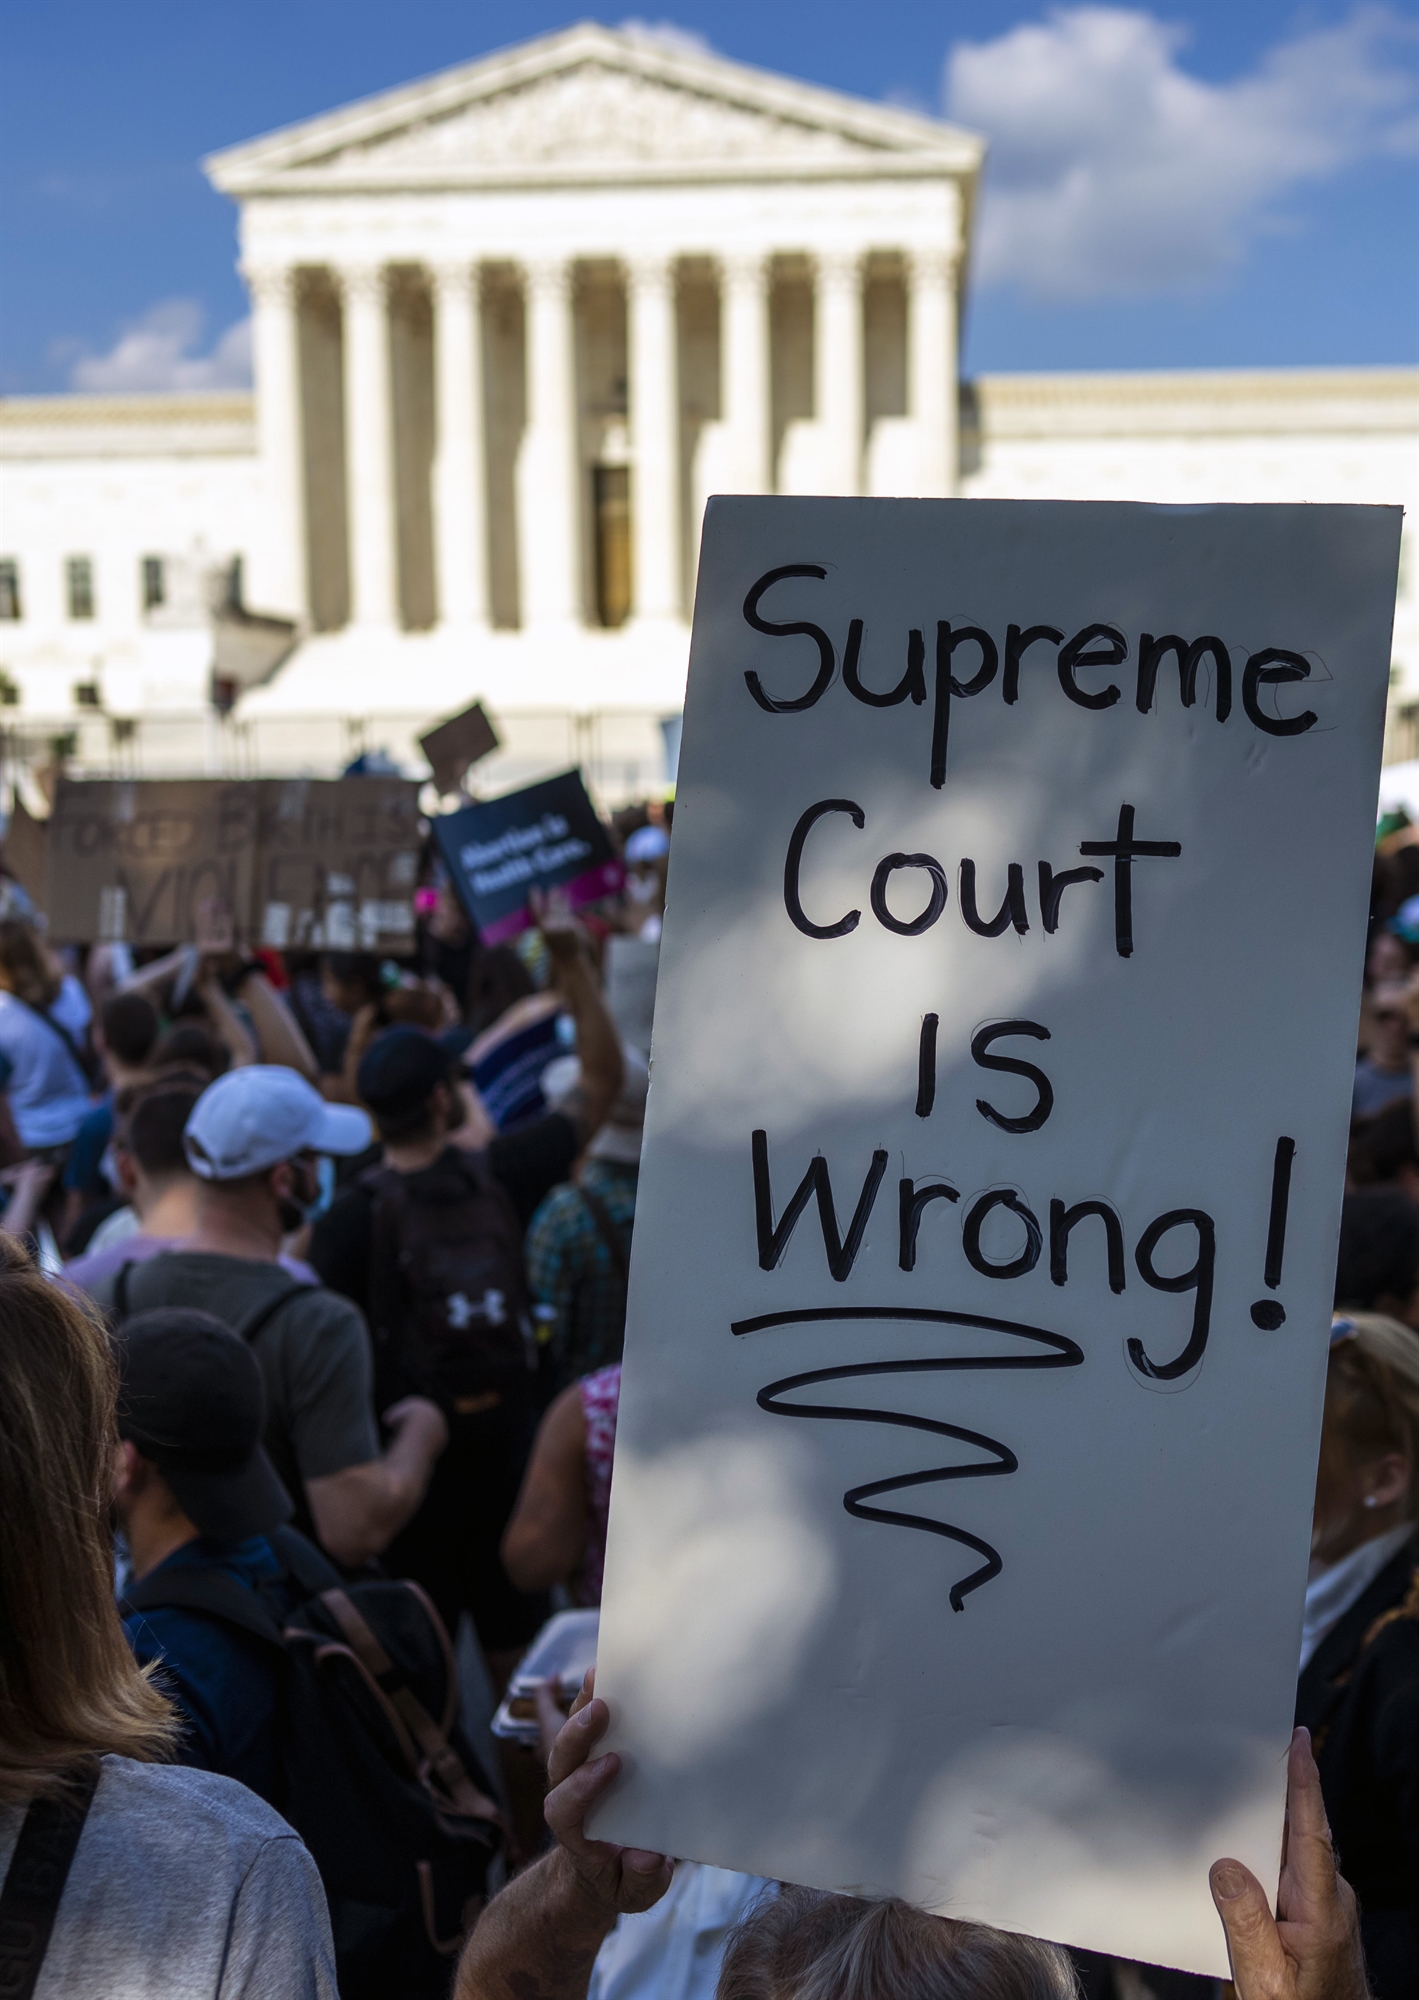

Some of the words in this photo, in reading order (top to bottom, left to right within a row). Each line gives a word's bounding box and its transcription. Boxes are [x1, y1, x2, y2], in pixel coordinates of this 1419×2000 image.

[743, 564, 1319, 790] Supreme
[784, 798, 1182, 958] Court
[916, 1012, 1054, 1134] IS
[752, 1128, 1297, 1381] Wrong!
